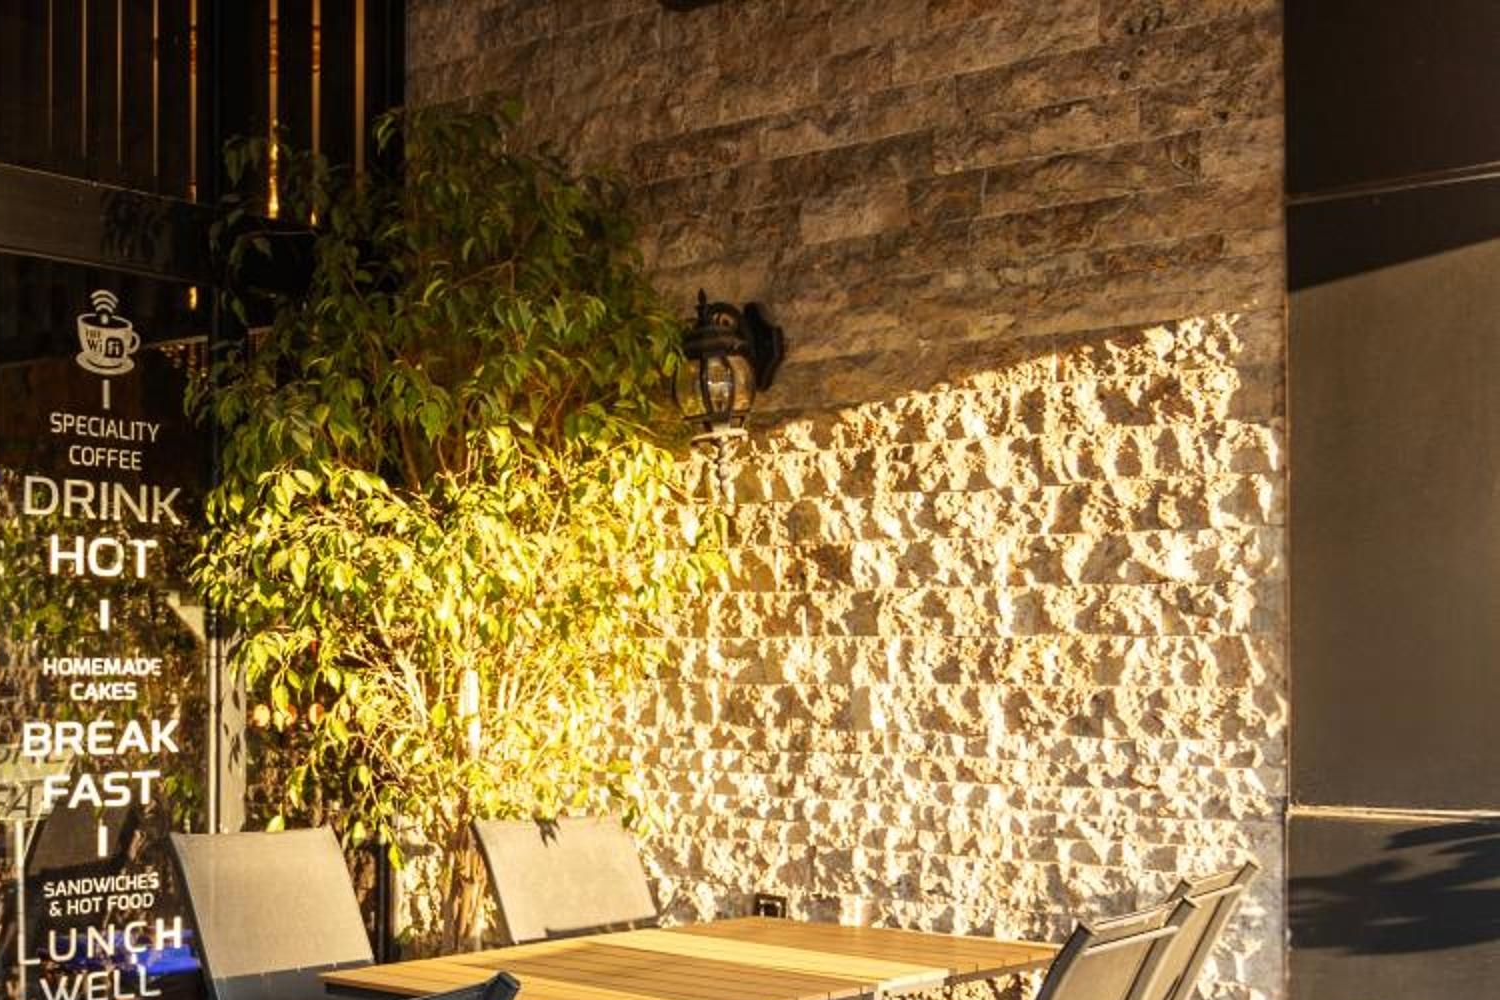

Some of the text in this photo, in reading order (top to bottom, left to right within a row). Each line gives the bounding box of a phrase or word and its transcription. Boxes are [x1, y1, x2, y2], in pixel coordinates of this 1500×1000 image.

[50, 411, 160, 442] SPECIALITY
[68, 445, 143, 471] COFFEE
[23, 475, 182, 526] DRINK
[50, 533, 159, 579] HOT
[43, 657, 163, 677] HOMEMADE
[69, 681, 137, 701] CAKES
[22, 718, 180, 758] BREAK
[42, 770, 161, 810] FAST
[43, 871, 160, 898] SANDWICHES
[49, 891, 155, 917] & HOT FOOD
[17, 915, 182, 966] LUNCH
